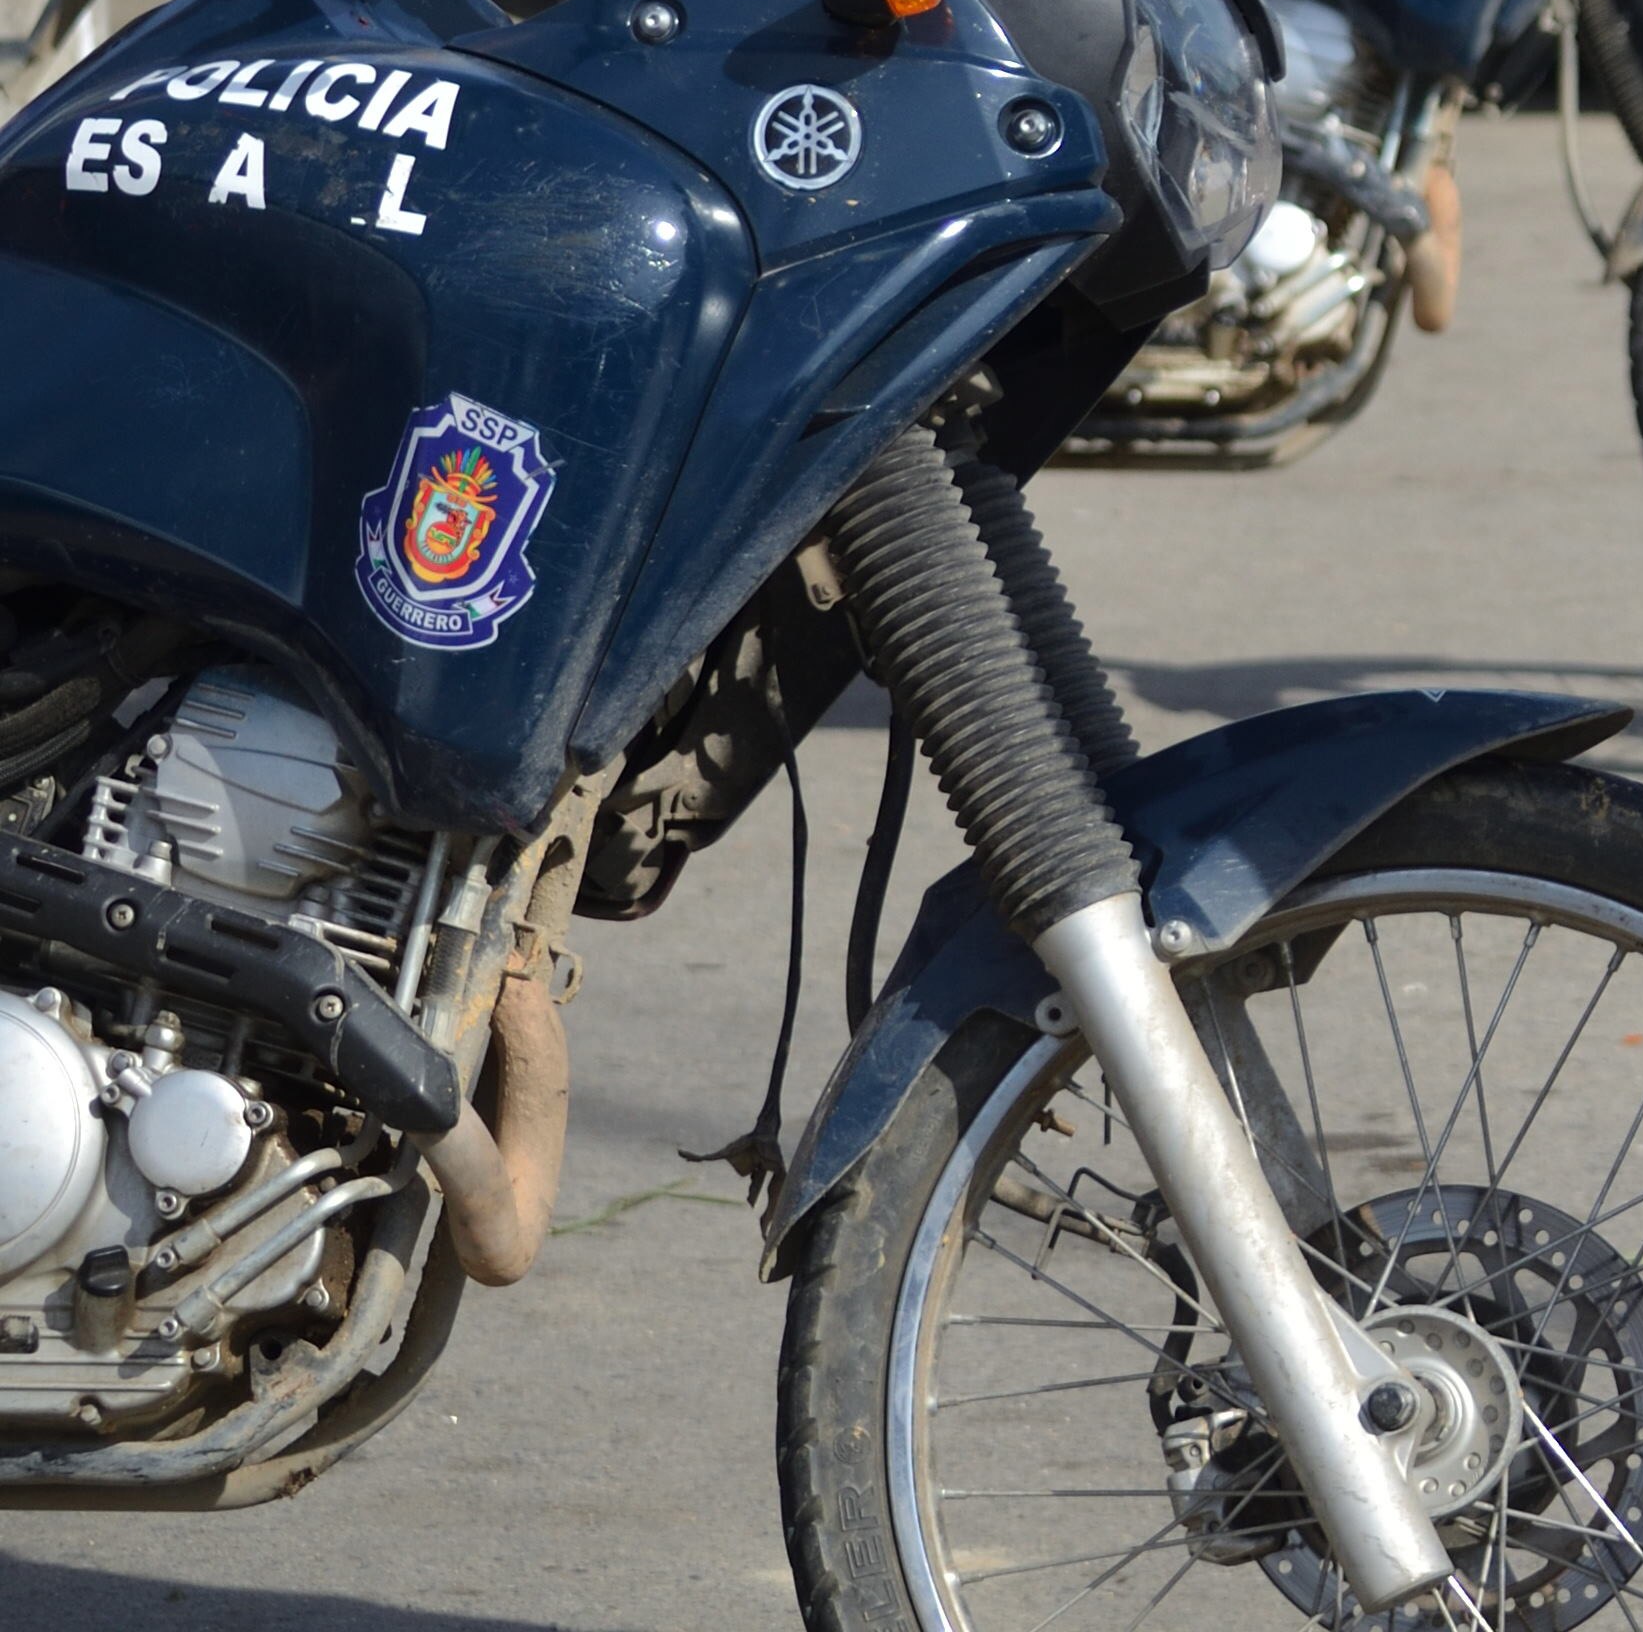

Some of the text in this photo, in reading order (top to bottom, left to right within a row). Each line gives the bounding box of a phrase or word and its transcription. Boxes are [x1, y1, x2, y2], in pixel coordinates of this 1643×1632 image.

[109, 58, 460, 150] POLICIA
[461, 408, 518, 446] SSP
[375, 577, 463, 631] GUERRERO
